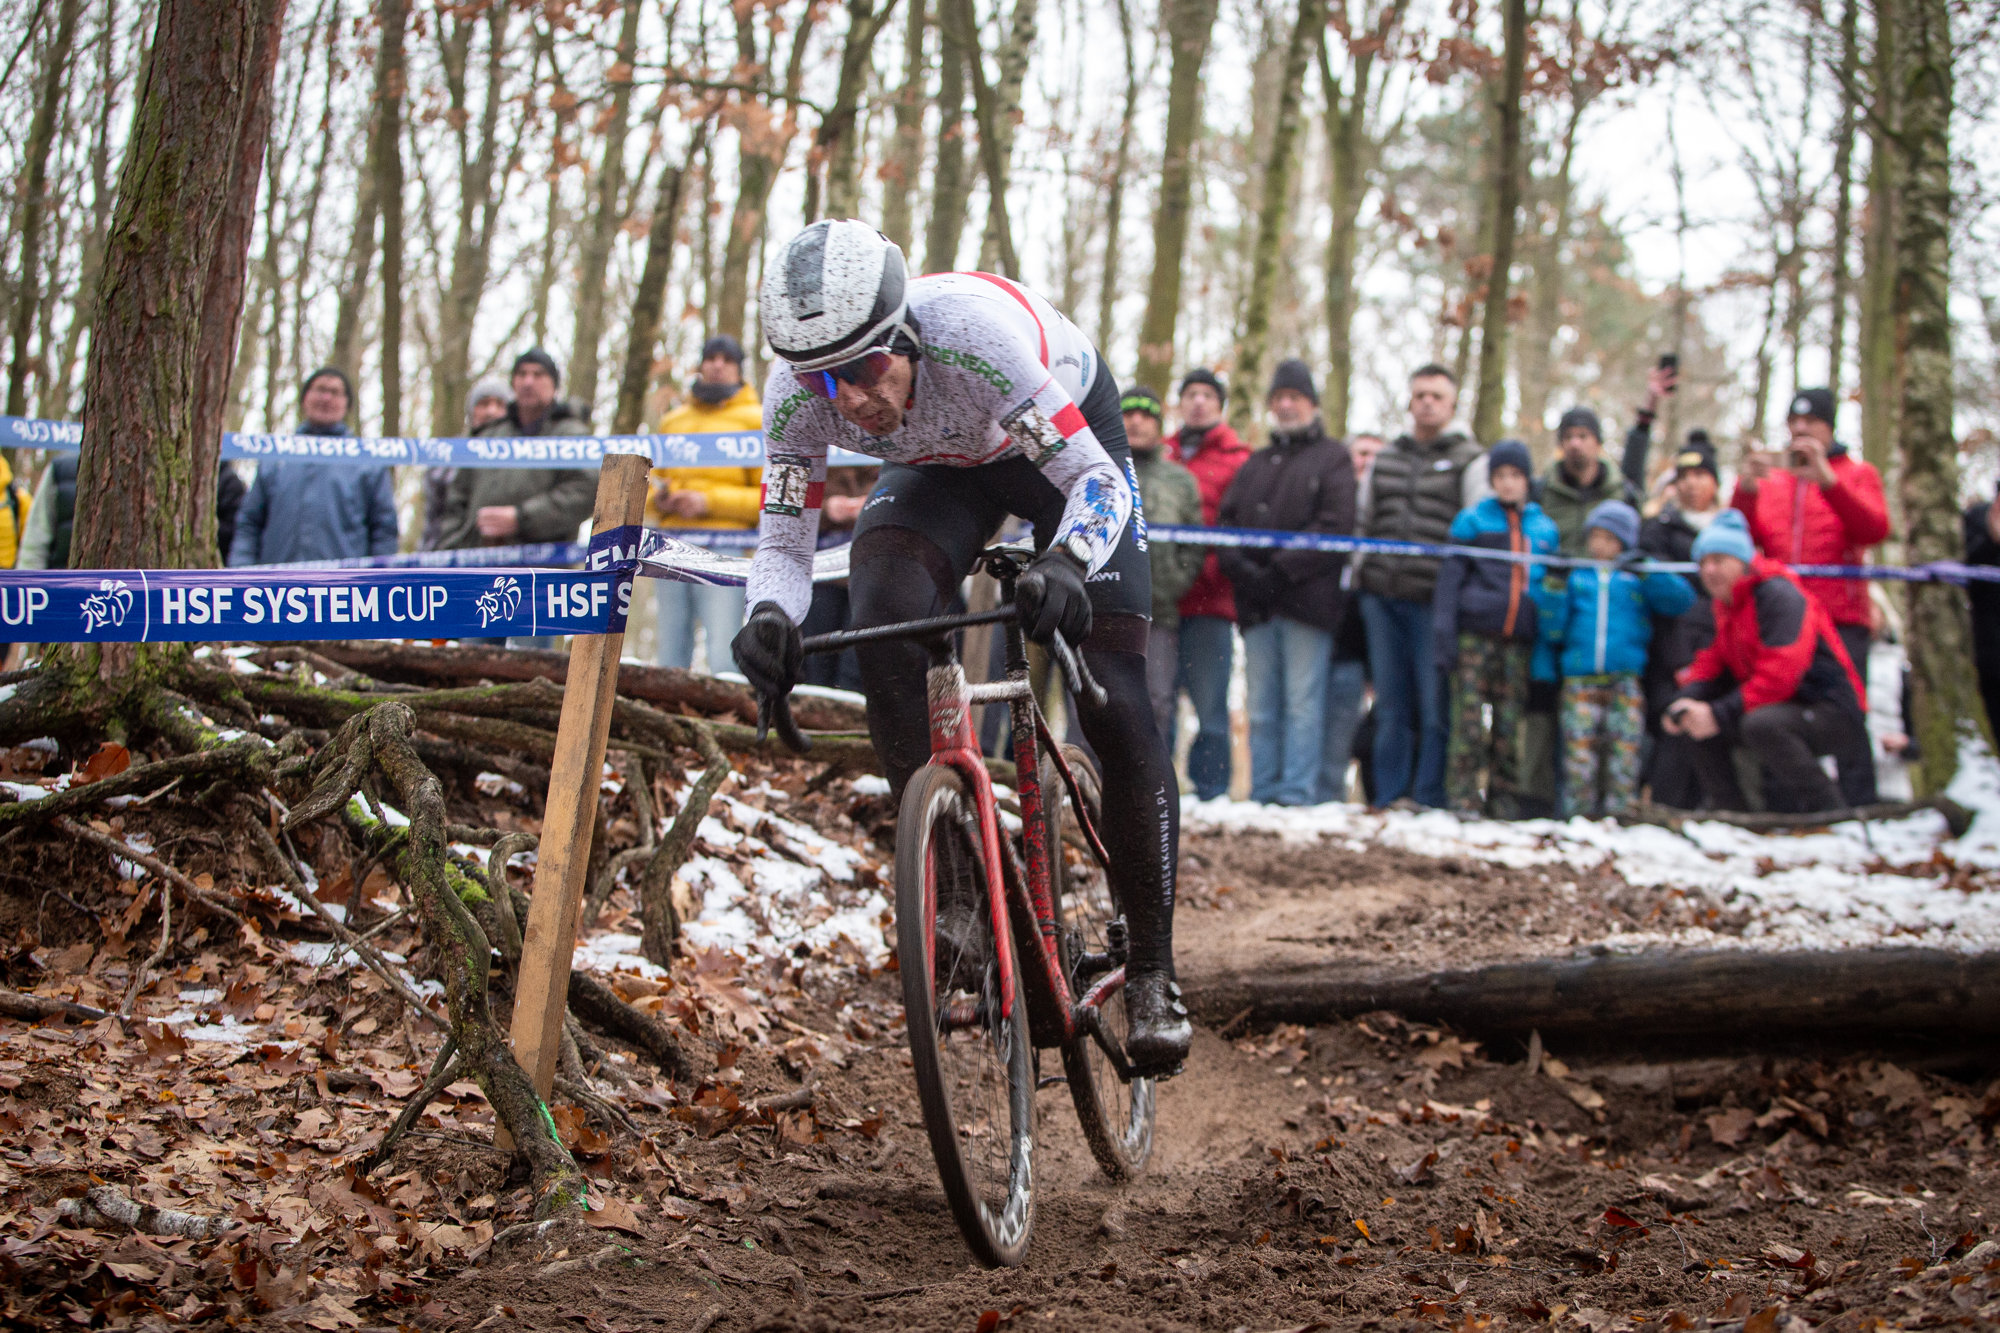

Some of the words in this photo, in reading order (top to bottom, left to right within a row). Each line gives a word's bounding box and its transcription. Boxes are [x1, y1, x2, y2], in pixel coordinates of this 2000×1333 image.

[162, 587, 232, 624] HSF
[242, 586, 380, 624] SYSTEM
[388, 586, 448, 622] CUP
[547, 582, 609, 618] HSF
